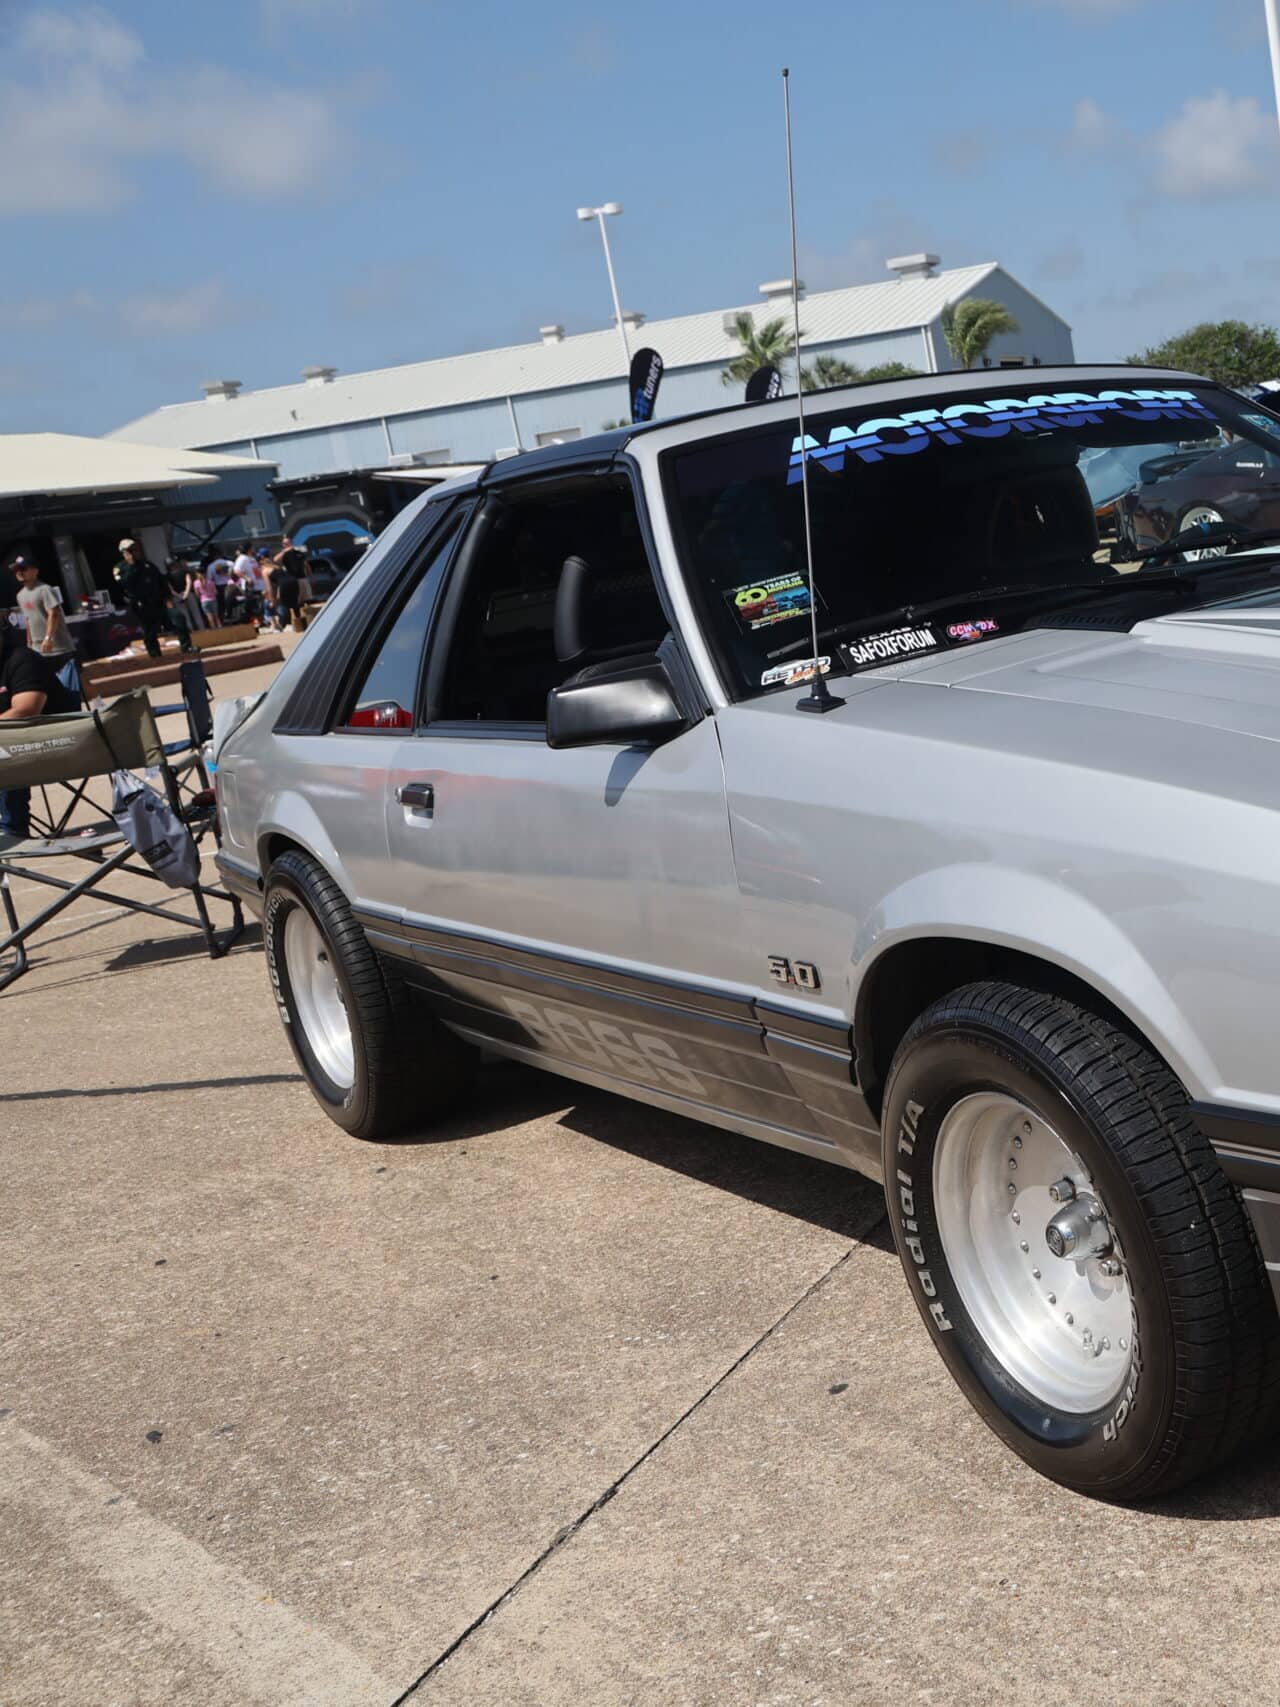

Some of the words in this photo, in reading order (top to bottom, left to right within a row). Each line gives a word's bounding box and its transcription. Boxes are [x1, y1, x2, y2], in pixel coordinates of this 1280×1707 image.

[786, 389, 1220, 486] MOTORSPORT
[734, 587, 768, 607] 60
[764, 577, 790, 590] YEARS
[848, 629, 937, 665] SAFOXFORUM
[767, 954, 822, 989] 5.0
[897, 1099, 926, 1156] T/A
[896, 1169, 954, 1332] Radial
